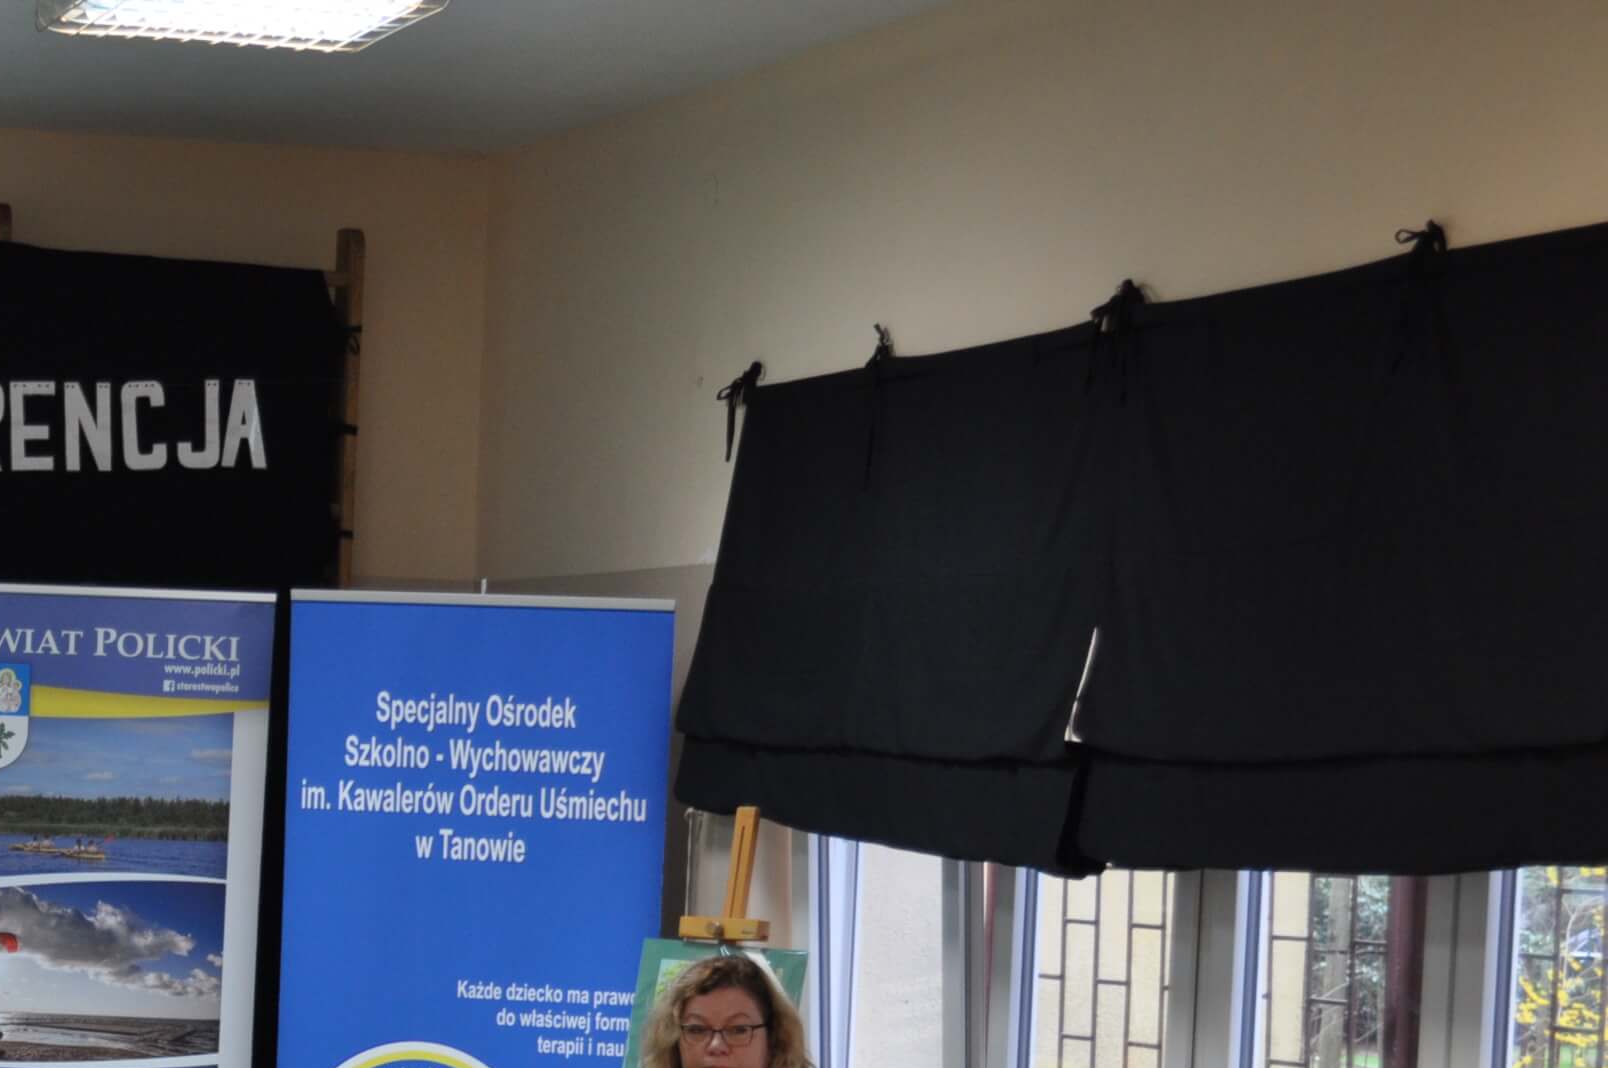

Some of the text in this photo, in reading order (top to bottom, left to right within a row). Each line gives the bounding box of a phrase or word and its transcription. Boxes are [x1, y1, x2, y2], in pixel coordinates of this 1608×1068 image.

[93, 627, 241, 662] POLICKI
[376, 690, 577, 732] Specjalny Ośrodek
[344, 735, 430, 769] Szkolno
[449, 739, 605, 782] Wychowawczy
[300, 779, 648, 823] im. Kawalerów Orderu Uśmiechu
[416, 829, 527, 863] w Tanowie
[456, 979, 502, 1001] Każde
[505, 982, 563, 1003] dziecko
[567, 989, 589, 1004] ma
[496, 1008, 516, 1026] do
[519, 1009, 592, 1034] właściwej
[537, 1035, 584, 1059] terapii
[587, 1038, 593, 1056] i
